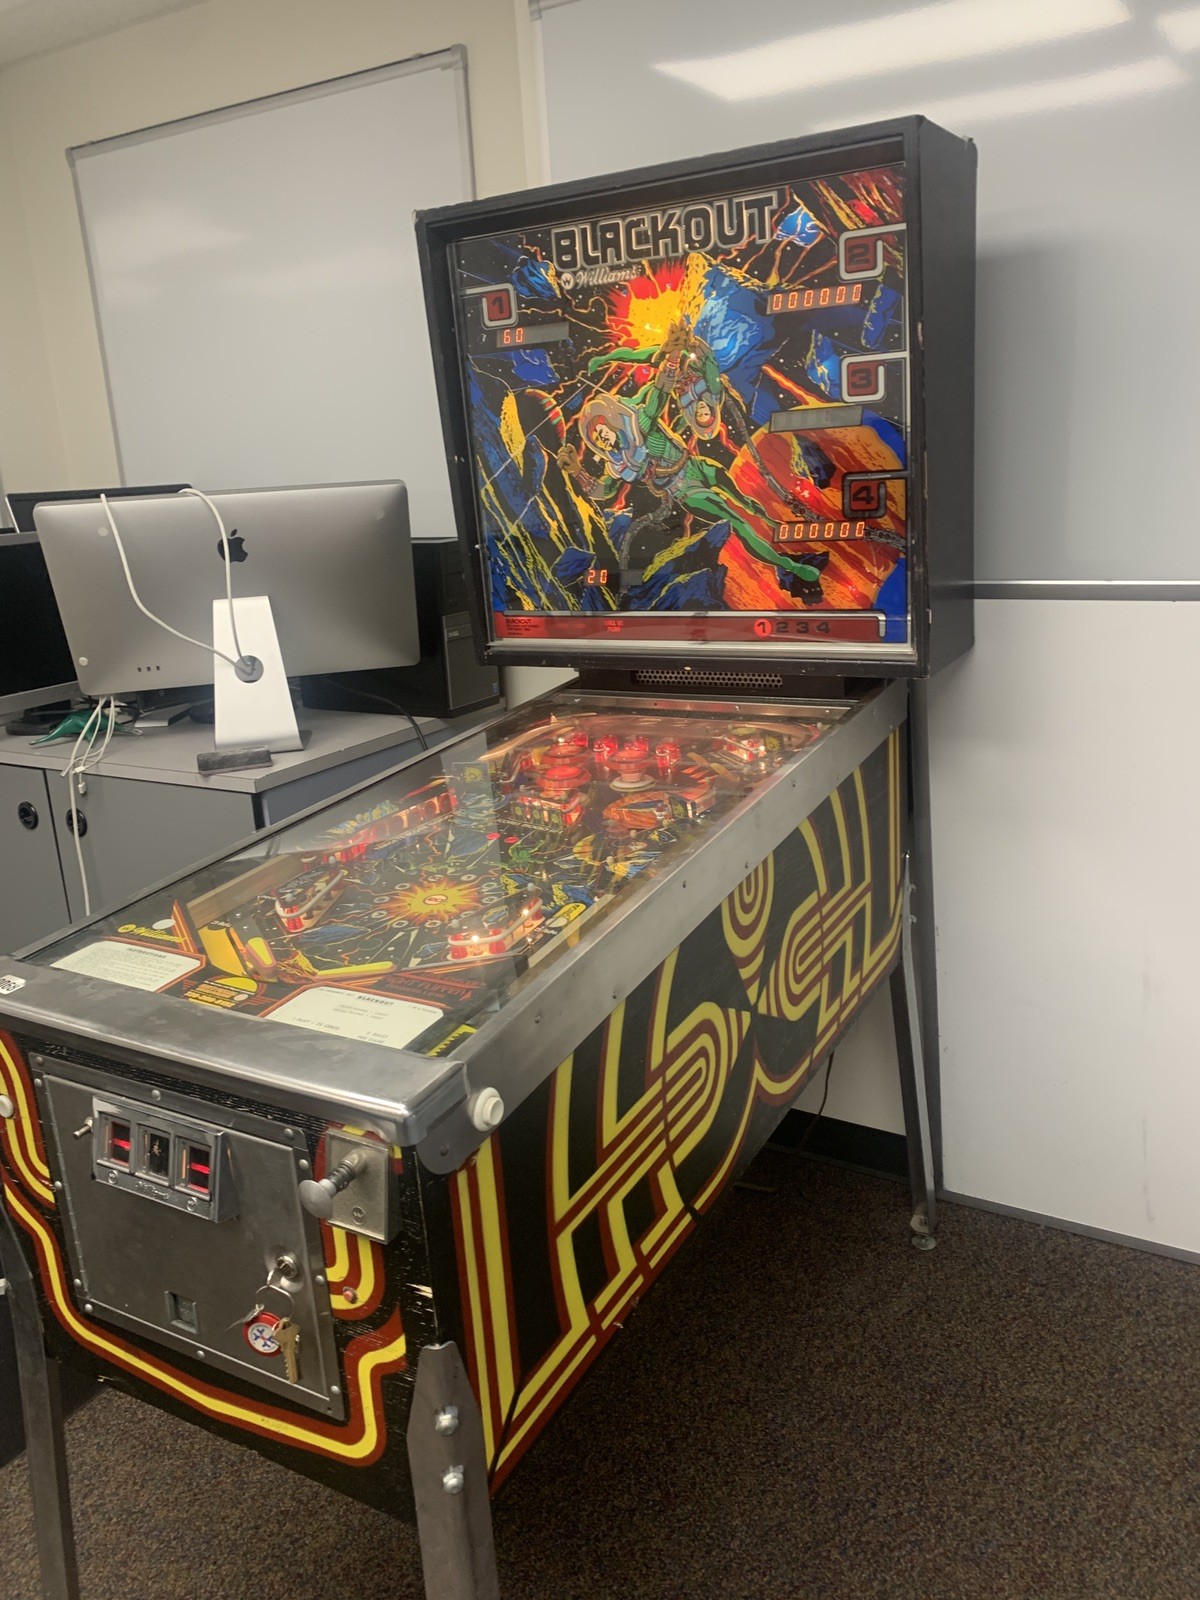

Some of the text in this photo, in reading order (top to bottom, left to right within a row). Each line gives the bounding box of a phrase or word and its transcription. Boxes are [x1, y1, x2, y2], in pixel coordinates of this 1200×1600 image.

[551, 191, 778, 271] BLACKOUT
[850, 243, 871, 266] 2
[575, 265, 638, 290] Williams
[492, 297, 505, 315] 1
[503, 327, 524, 344] 60
[851, 368, 873, 390] 3
[852, 485, 874, 505] 4
[587, 569, 608, 584] 20
[756, 621, 831, 634] 1 2 3 4
